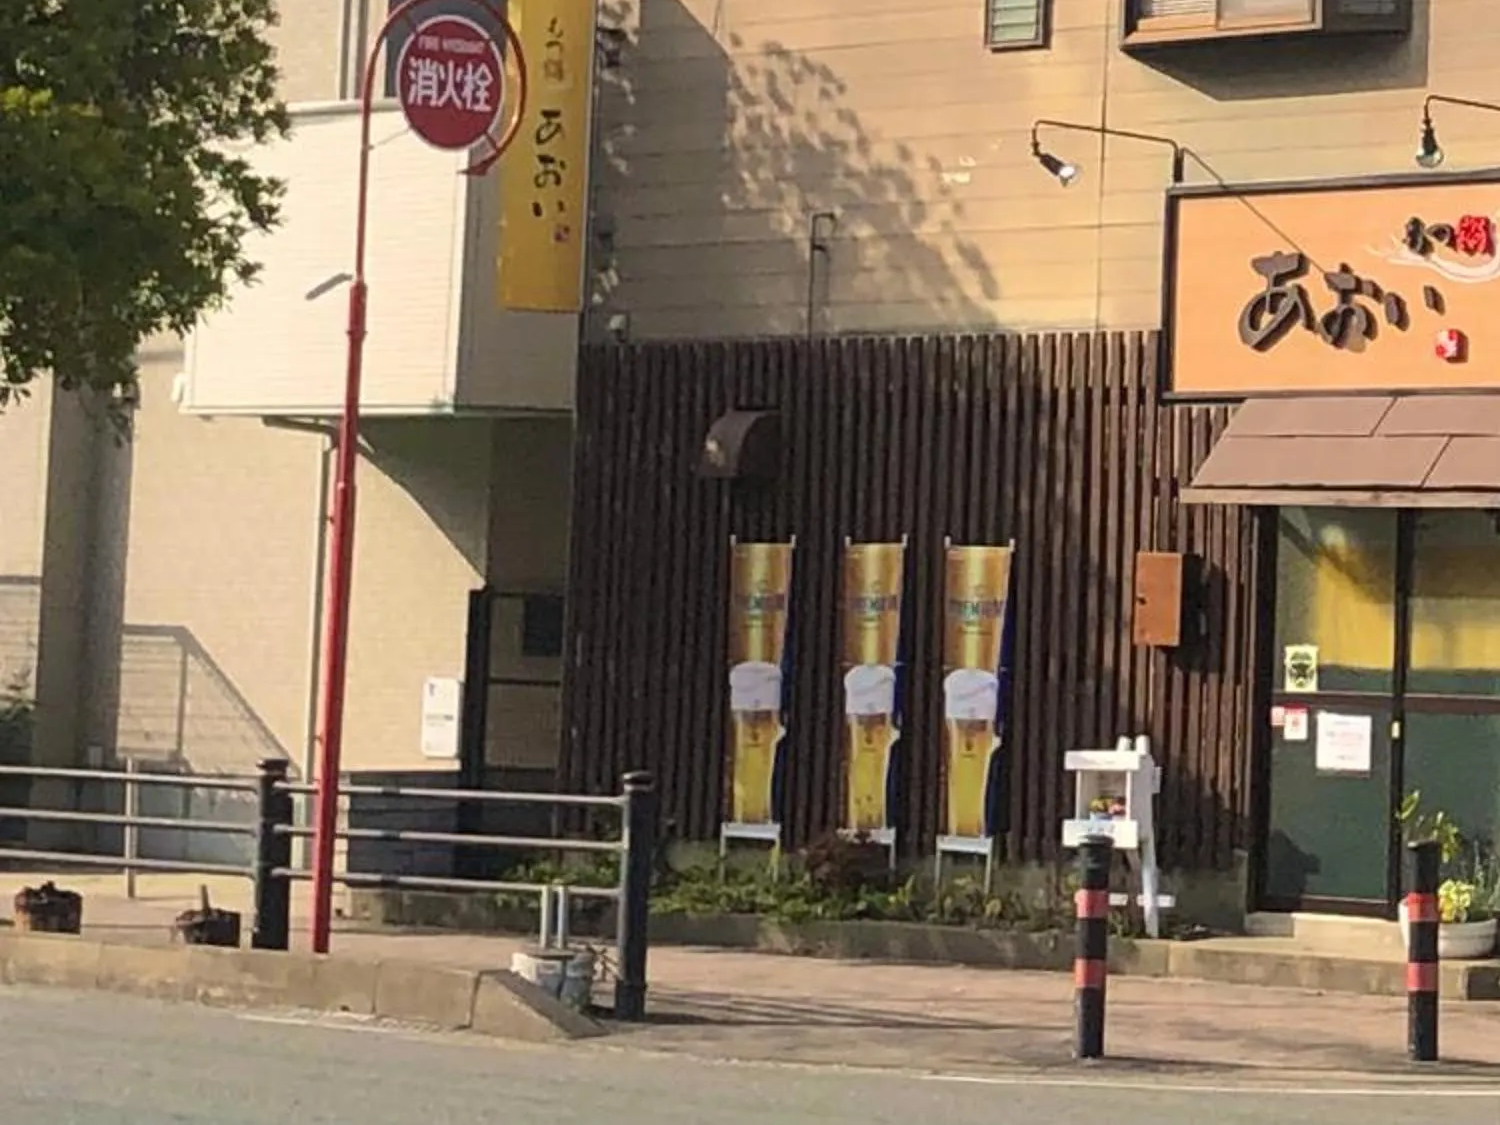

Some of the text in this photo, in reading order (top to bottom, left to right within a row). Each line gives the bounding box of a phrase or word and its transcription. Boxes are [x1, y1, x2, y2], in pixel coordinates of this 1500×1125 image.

[408, 56, 494, 112] 消火栓
[532, 109, 567, 217] あおい
[1237, 250, 1446, 353] あおい
